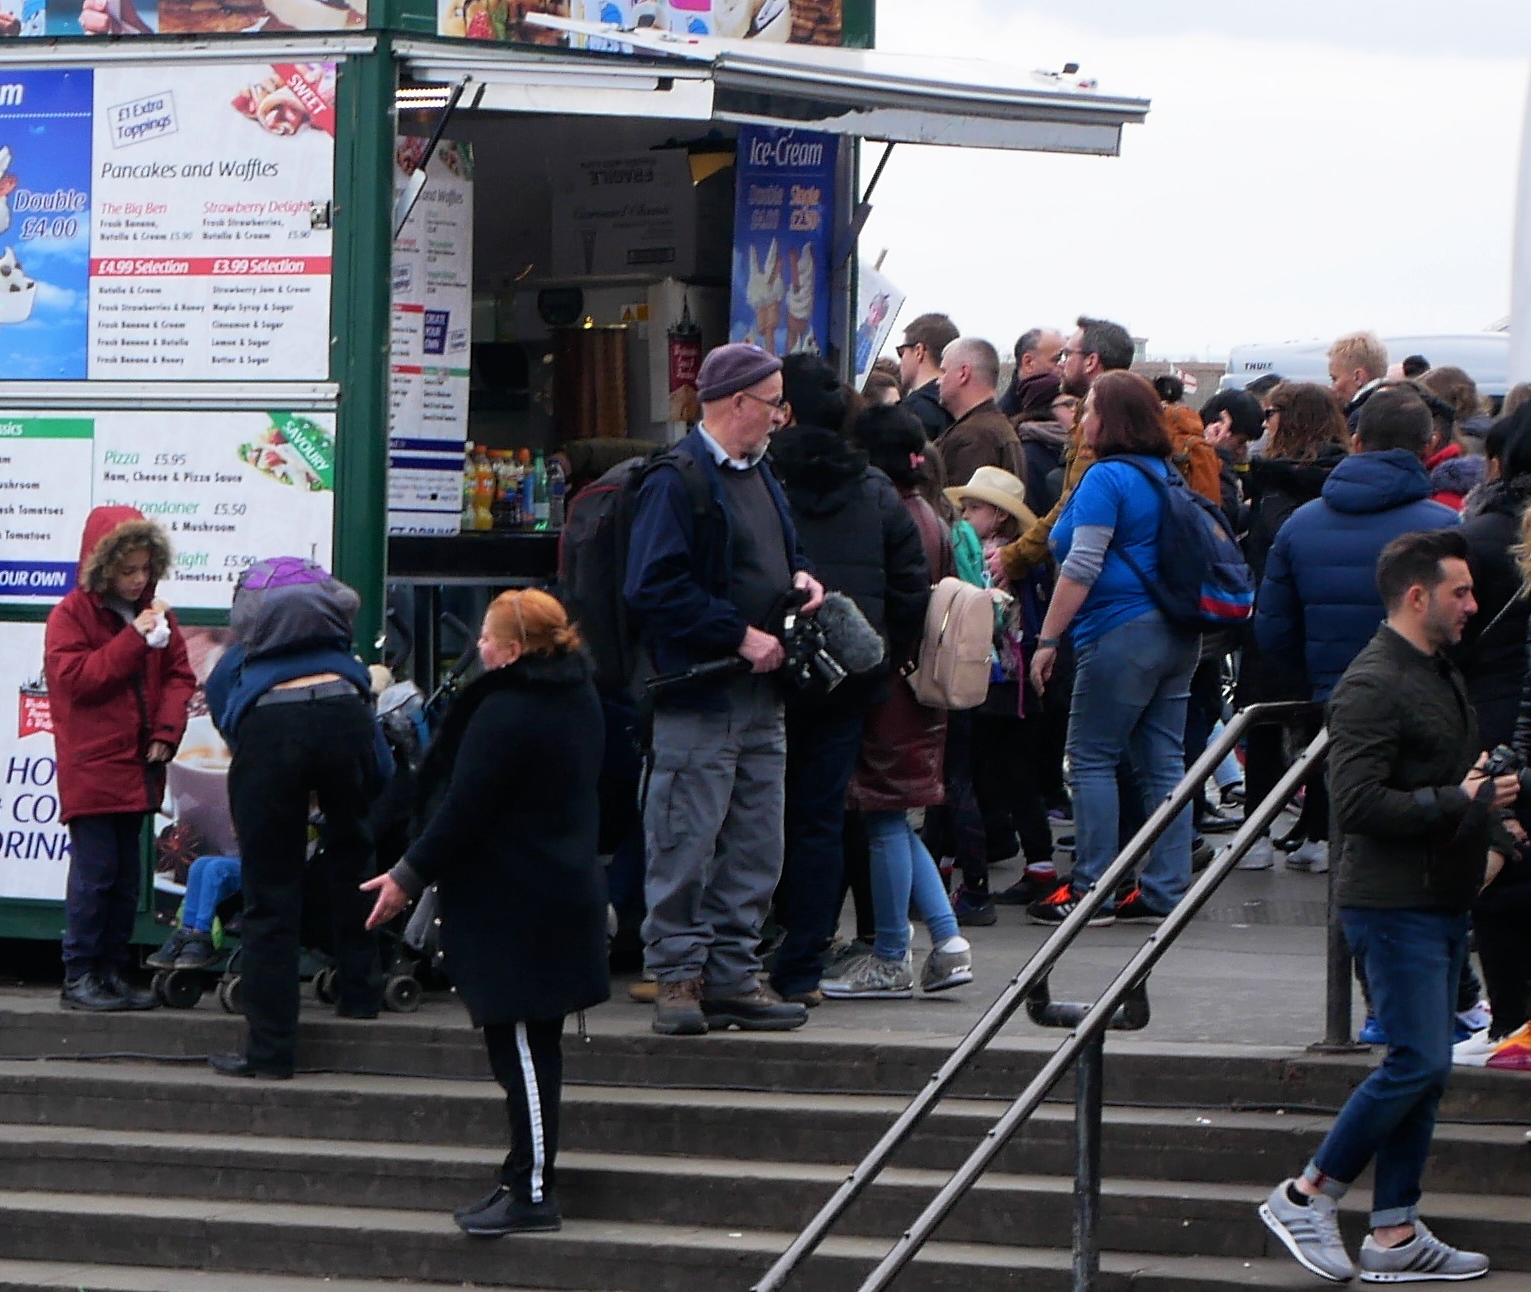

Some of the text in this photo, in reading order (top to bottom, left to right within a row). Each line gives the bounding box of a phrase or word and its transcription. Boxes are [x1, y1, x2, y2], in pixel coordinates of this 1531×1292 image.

[288, 74, 327, 115] SWEET
[117, 100, 163, 122] £1 Extra
[116, 113, 171, 139] Toppings
[749, 136, 823, 166] Ice-Cream
[101, 158, 279, 181] Pancakes and Waffles
[13, 190, 86, 212] Double
[203, 201, 311, 216] Strawberry Delight
[102, 202, 167, 217] The Big Ben
[20, 217, 78, 238] £4.00
[98, 259, 189, 275] £4.99 Selection
[212, 259, 304, 274] £3.99 Selection
[1245, 362, 1273, 370] THULE
[282, 421, 329, 471] SAVOURY
[103, 450, 186, 465] Pizza £5.95
[104, 473, 243, 482] Ham, Cheese & Pizza Sauce
[19, 505, 64, 515] Tomatoes
[214, 504, 246, 515] £5.50
[172, 522, 235, 532] & Mushroom
[5, 530, 51, 540] Tomatoes
[224, 556, 257, 567] £5.90
[31, 571, 66, 586] OWN
[175, 572, 222, 582] Tomatoes
[228, 572, 233, 581] &
[6, 757, 57, 786] HO
[12, 794, 57, 824] CO
